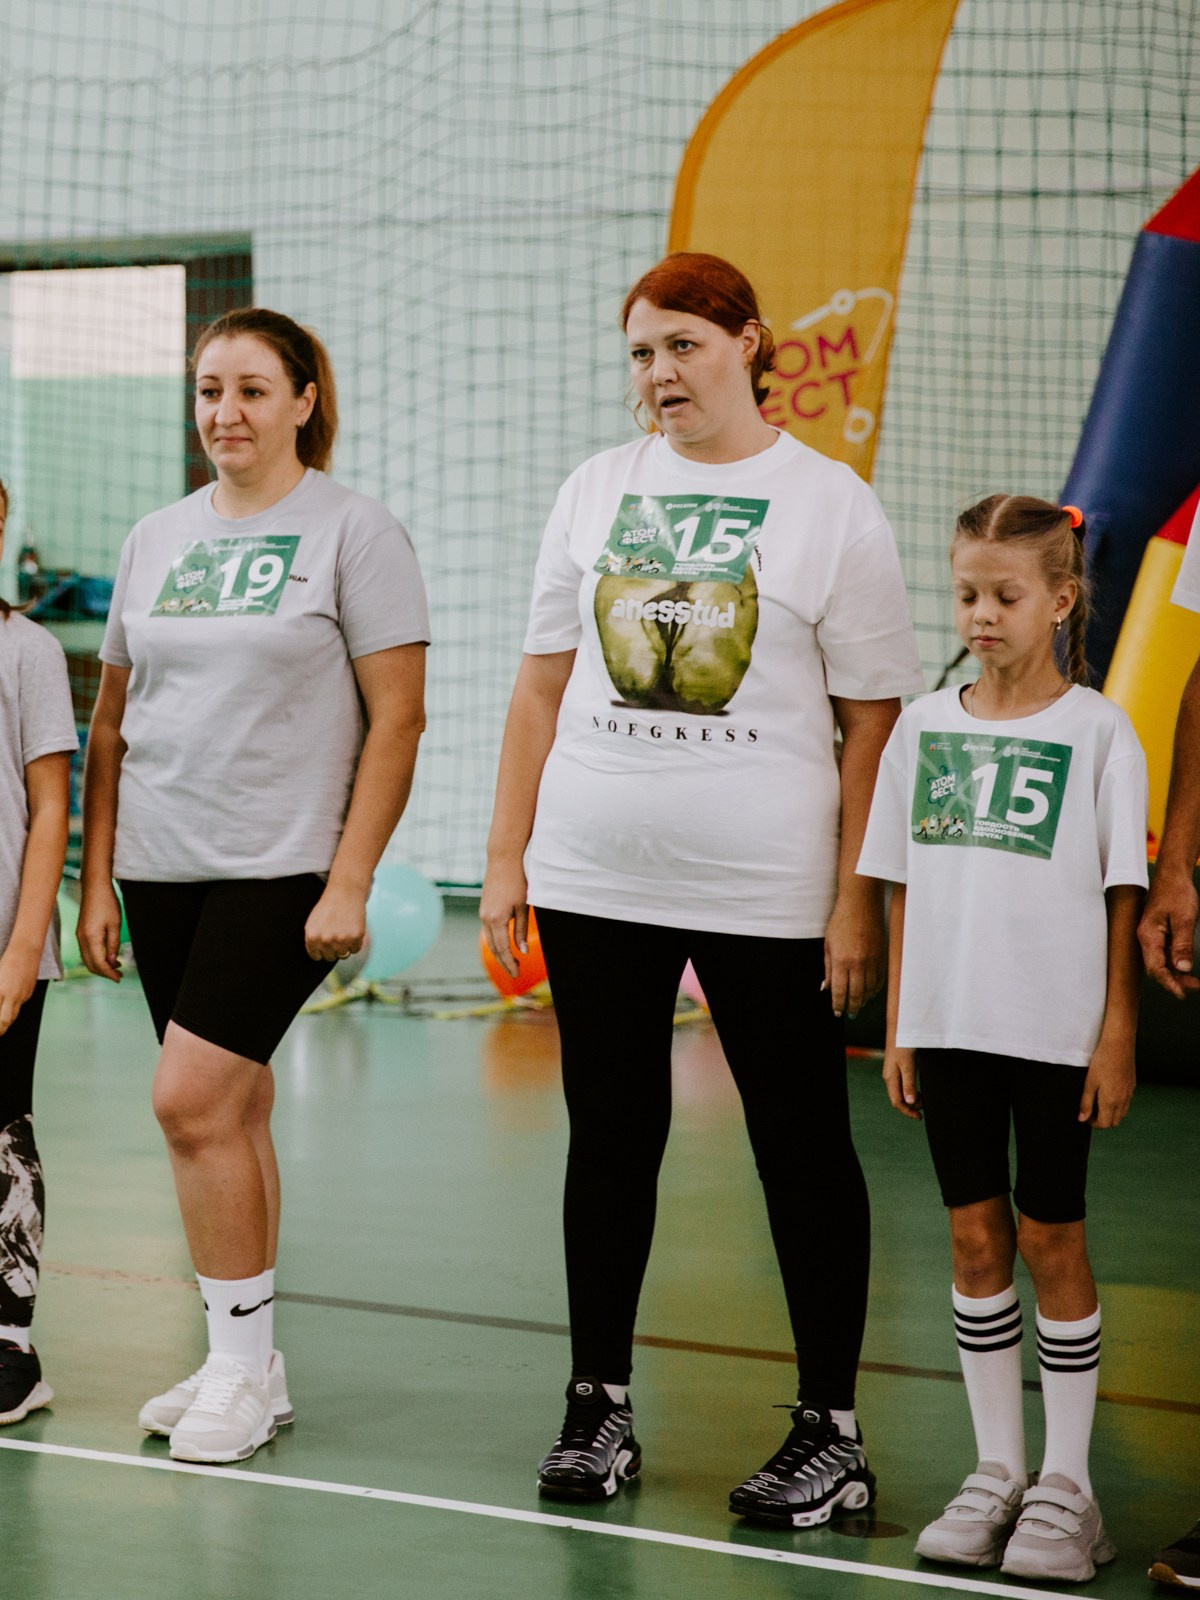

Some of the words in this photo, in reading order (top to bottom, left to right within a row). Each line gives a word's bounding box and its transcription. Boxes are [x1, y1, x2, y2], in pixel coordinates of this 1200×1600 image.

[773, 325, 860, 380] ОМ
[759, 367, 860, 428] ЕСТ
[621, 534, 656, 544] ФЕСТ
[622, 527, 657, 539] АТОМ
[673, 515, 751, 563] 15
[219, 554, 285, 599] 19
[611, 598, 735, 629] anesstud
[592, 716, 758, 743] NOEGKESS
[930, 773, 956, 791] АТОМ
[930, 783, 956, 800] ФЕСТ
[971, 762, 1054, 826] 15
